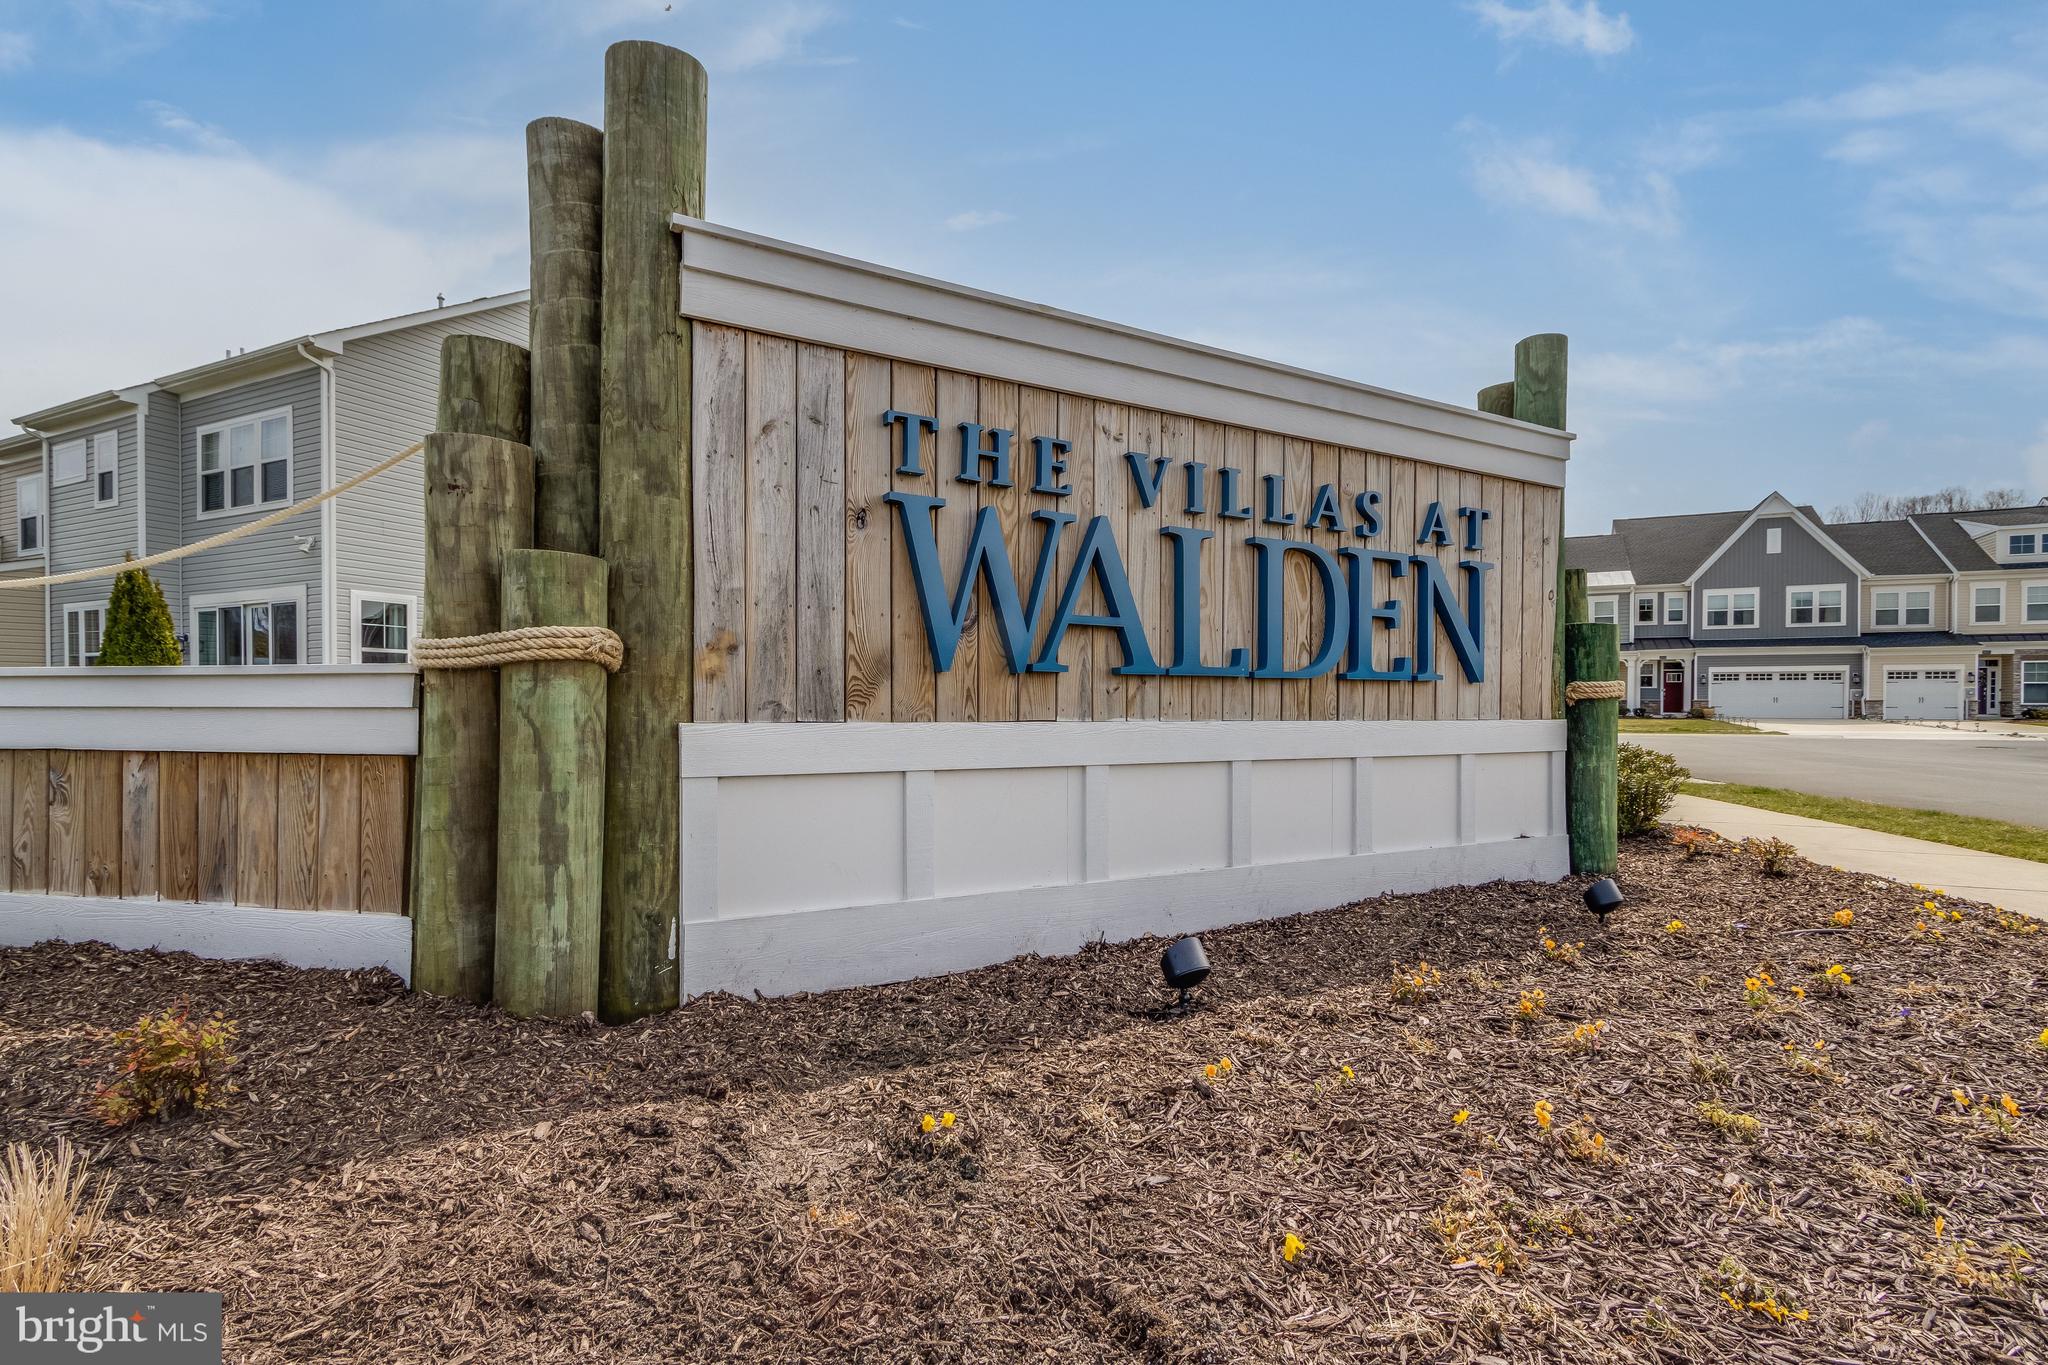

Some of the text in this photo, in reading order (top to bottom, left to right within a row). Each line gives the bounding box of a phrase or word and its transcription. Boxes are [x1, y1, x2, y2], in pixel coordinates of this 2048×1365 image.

[883, 410, 1492, 551] THE VILLAS AT
[883, 491, 1494, 683] WALDEN
